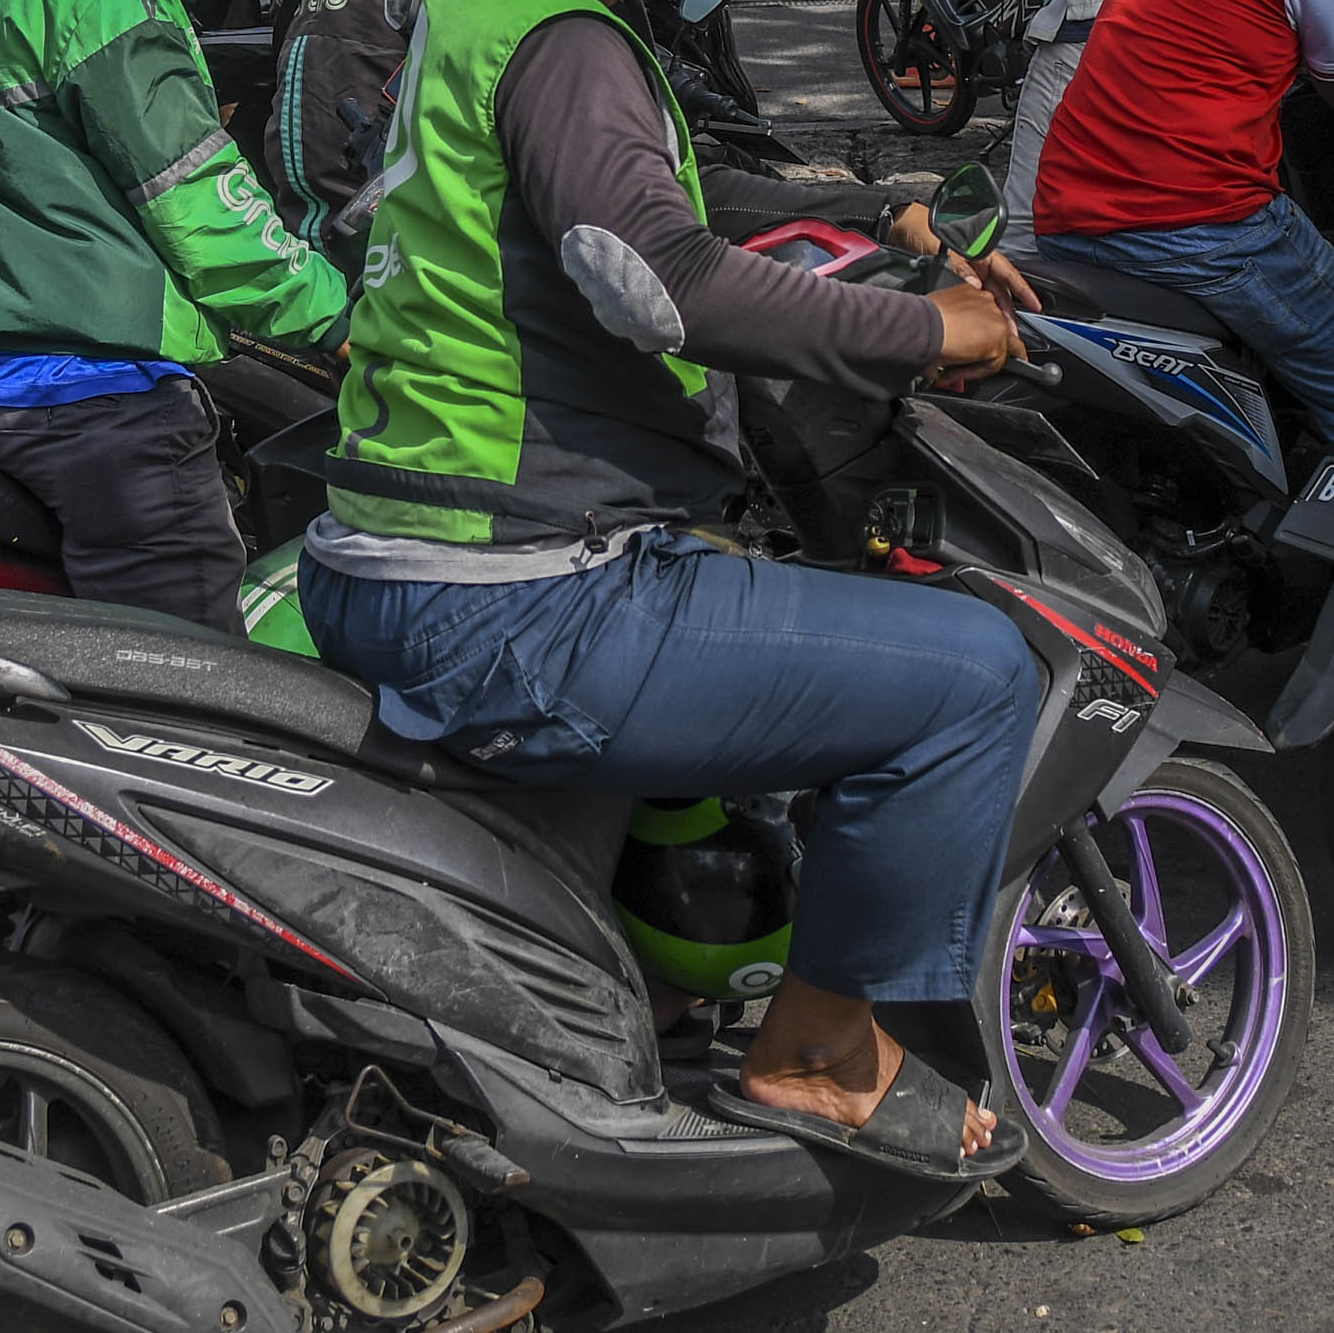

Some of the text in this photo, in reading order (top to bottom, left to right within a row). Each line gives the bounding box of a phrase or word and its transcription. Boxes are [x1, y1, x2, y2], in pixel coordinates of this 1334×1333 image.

[217, 154, 309, 275] Grab
[1077, 698, 1141, 734] FI
[73, 719, 335, 796] VARIO
